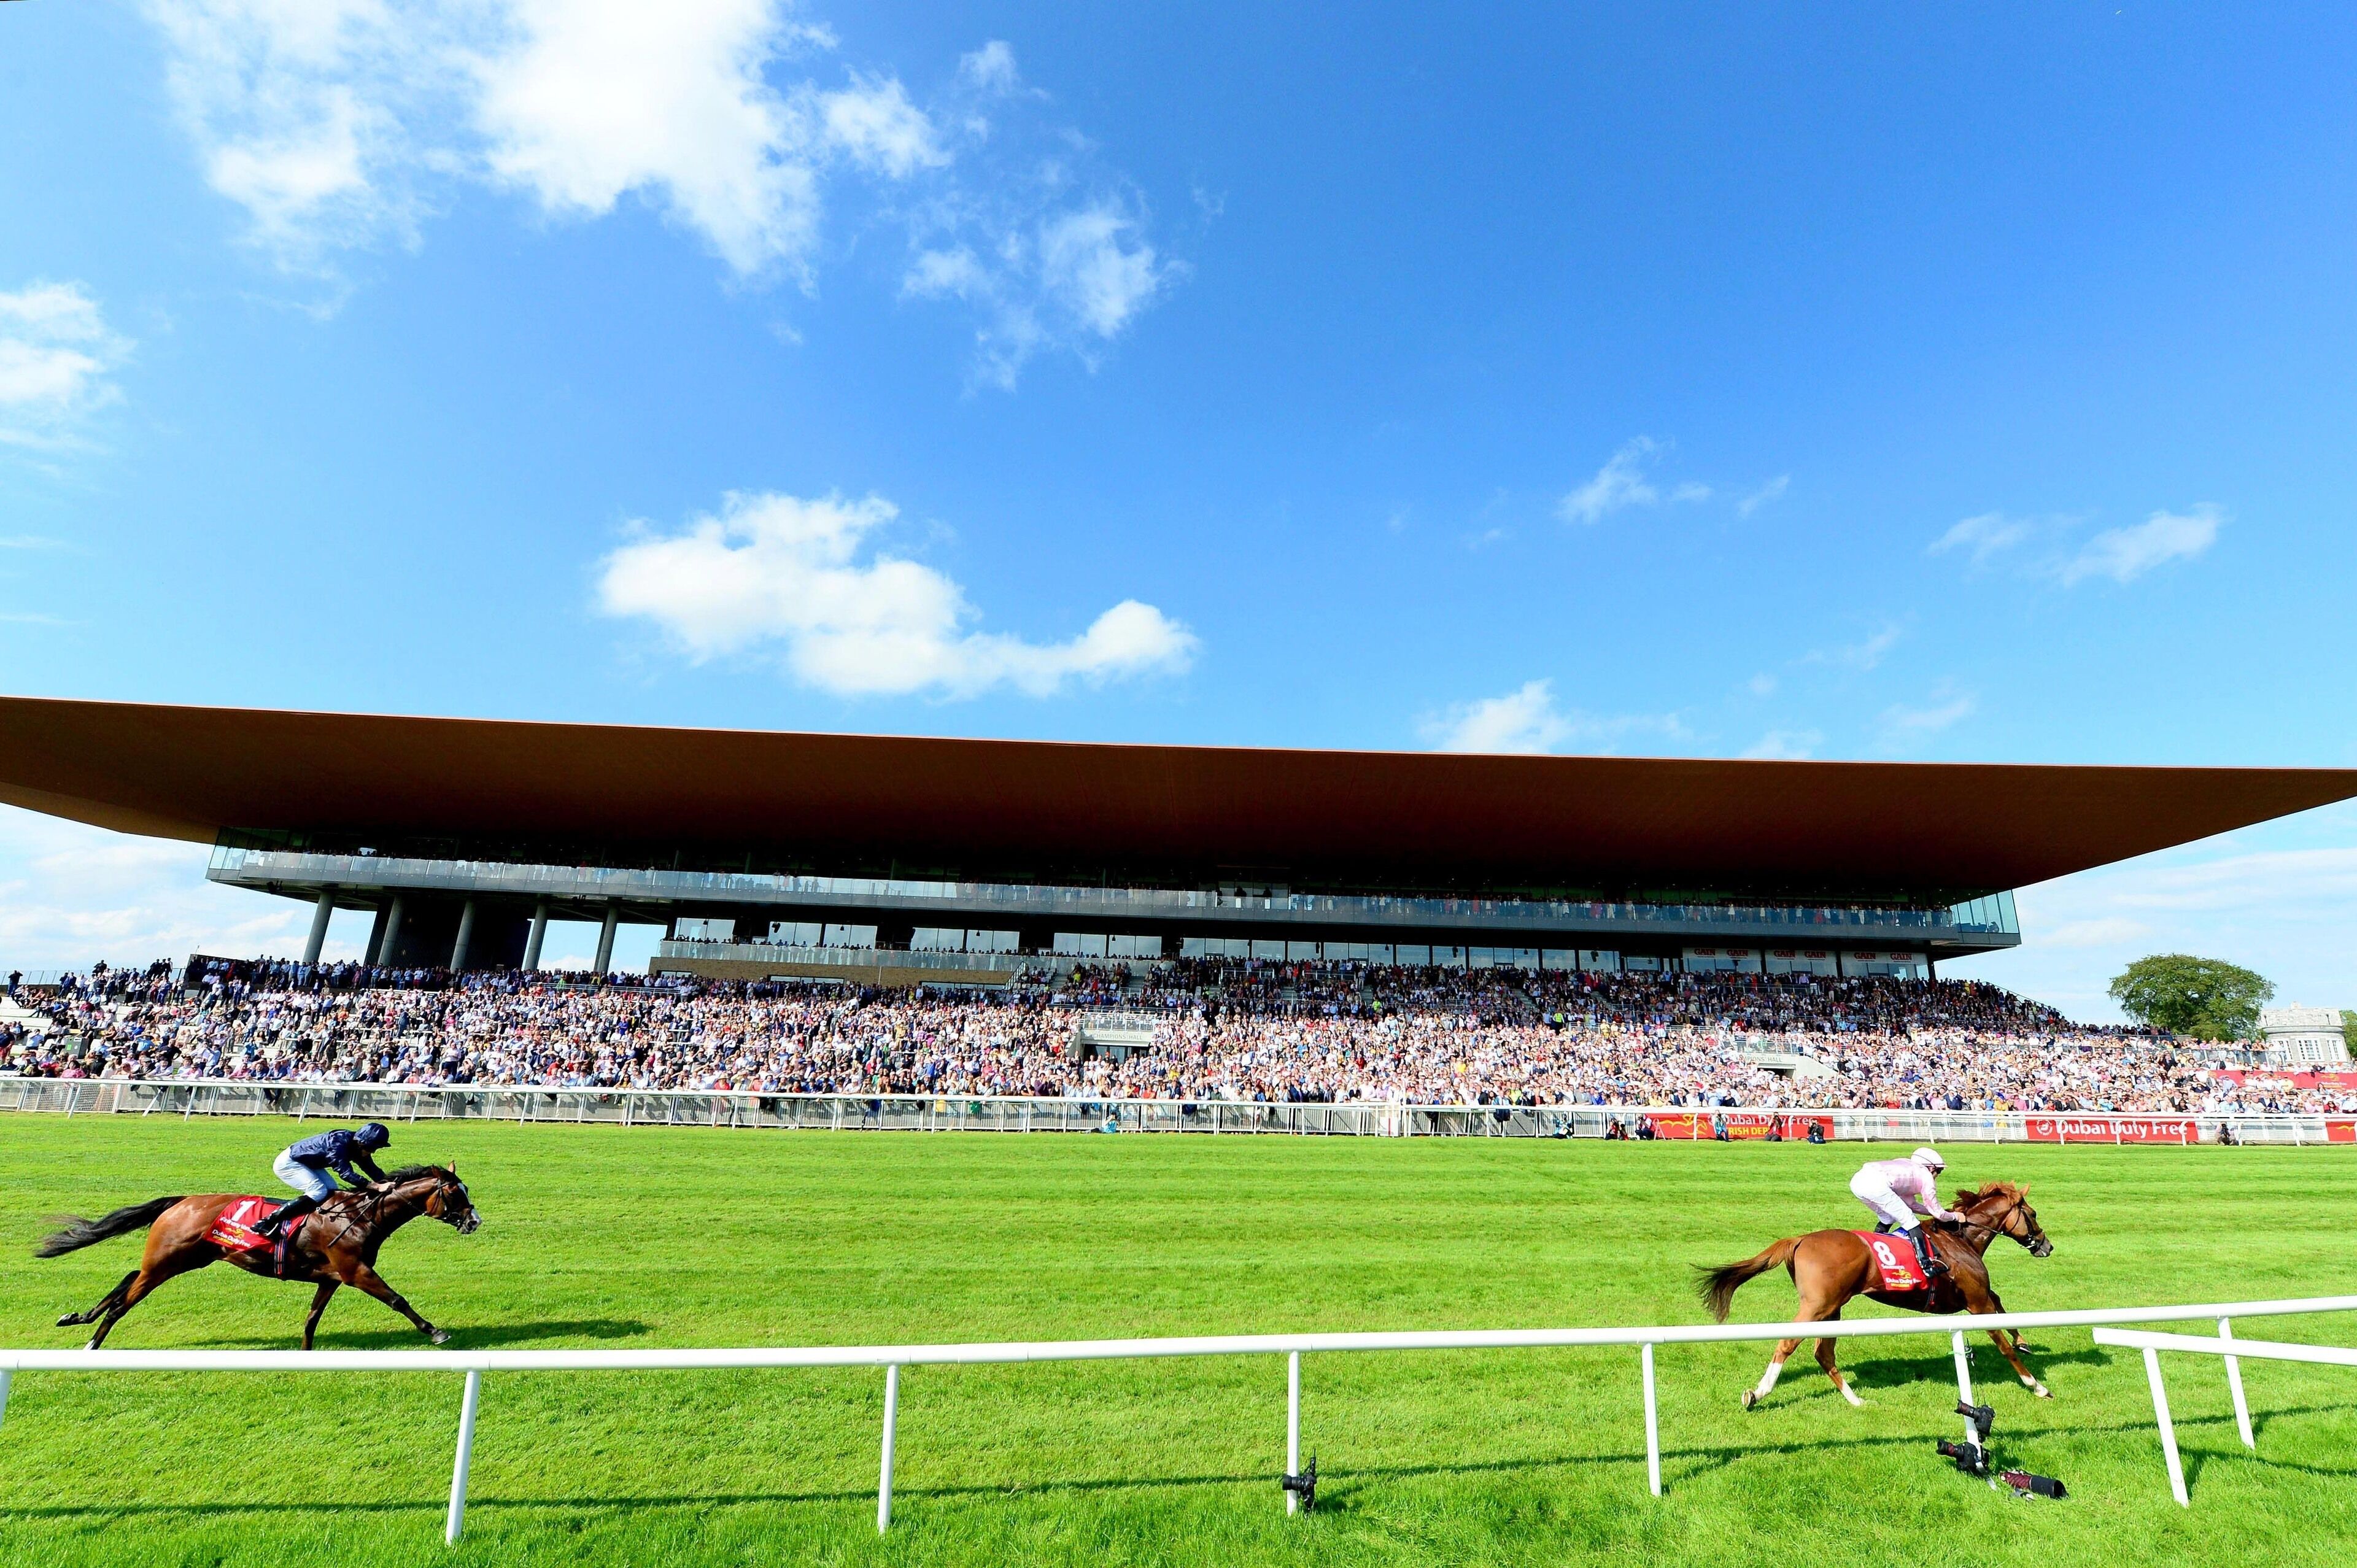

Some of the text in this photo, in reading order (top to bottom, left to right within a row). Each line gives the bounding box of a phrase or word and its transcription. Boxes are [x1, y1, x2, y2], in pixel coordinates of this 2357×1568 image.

[2057, 1120, 2105, 1134] Dubai
[2110, 1120, 2147, 1138] Duty
[2153, 1121, 2188, 1135] Free
[231, 1200, 257, 1222] 1
[1873, 1241, 1896, 1266] 8
